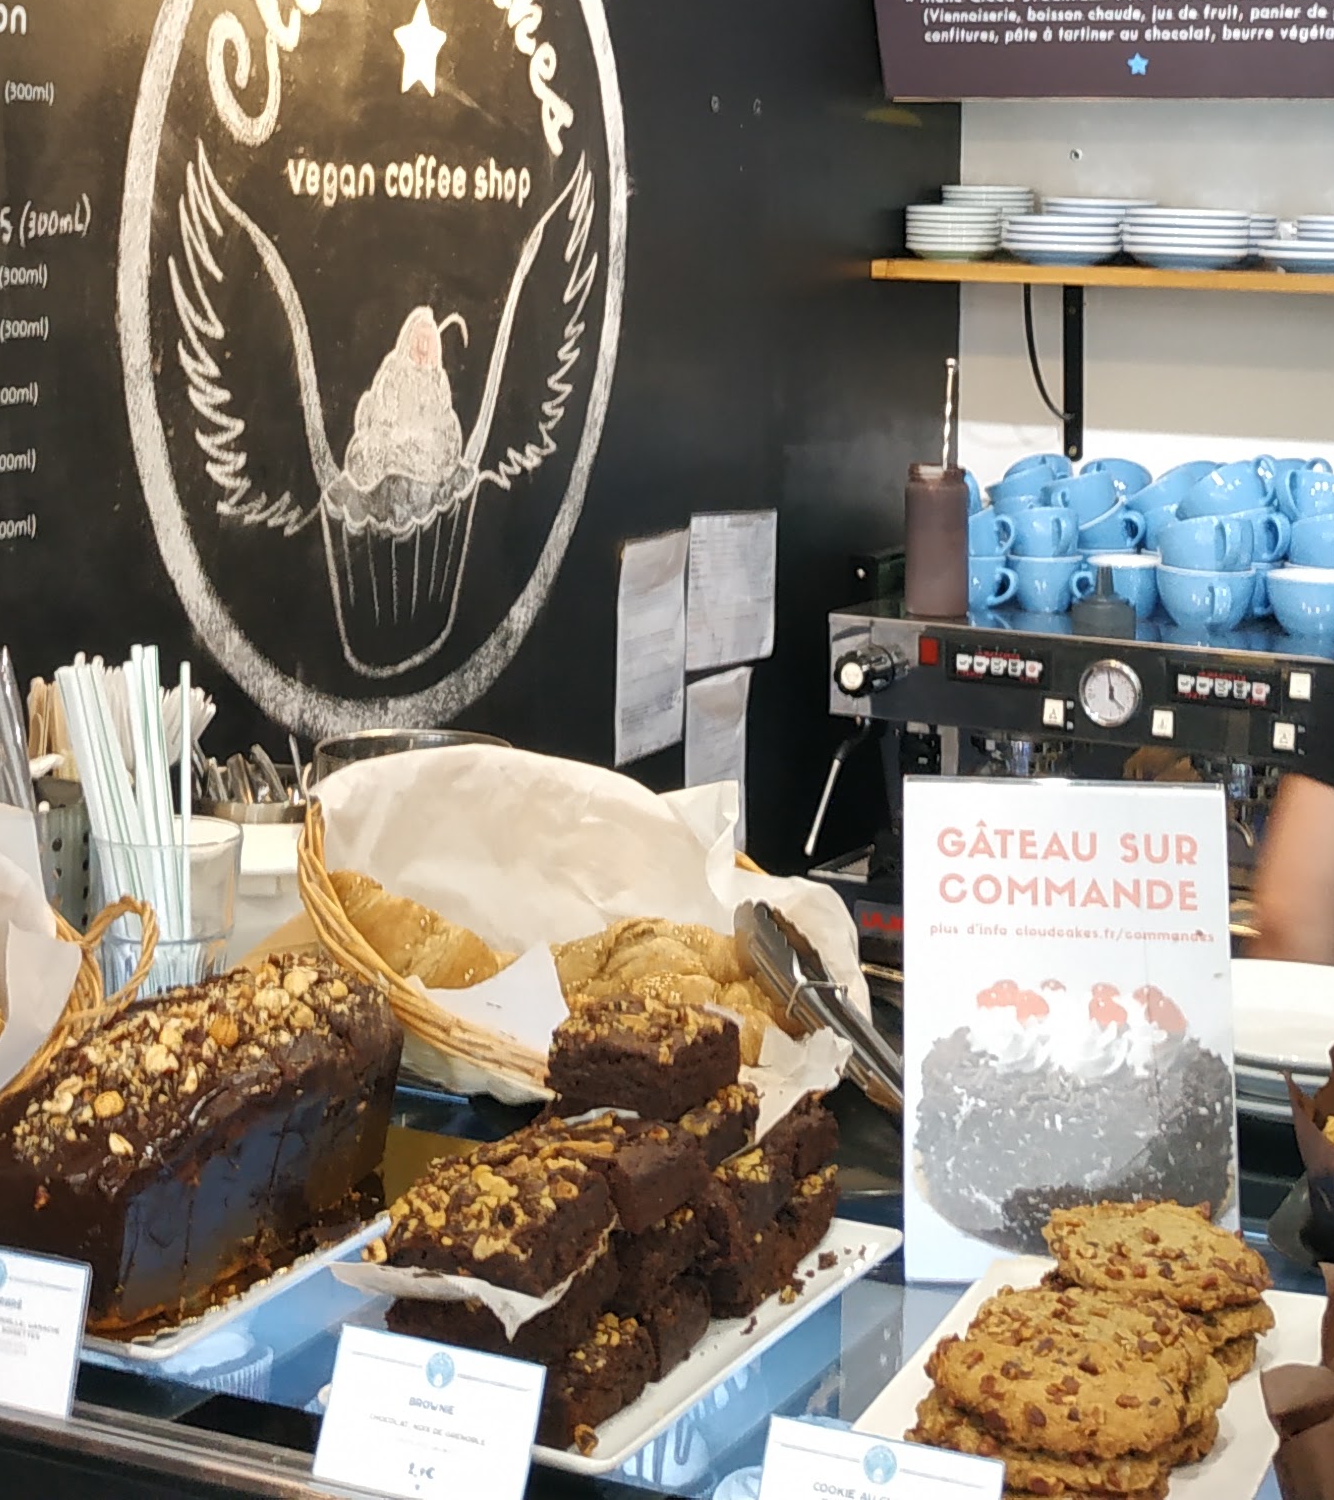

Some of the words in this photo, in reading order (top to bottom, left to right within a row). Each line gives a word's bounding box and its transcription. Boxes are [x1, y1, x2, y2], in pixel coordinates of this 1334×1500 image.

[5, 80, 54, 106] (300ml)
[286, 155, 376, 206] vegan
[385, 154, 467, 199] coffee
[474, 157, 530, 208] shop
[936, 819, 1098, 863] GÂTEAU
[1119, 833, 1199, 866] SUR
[939, 873, 1198, 911] COMMANDE
[930, 922, 958, 936] plus
